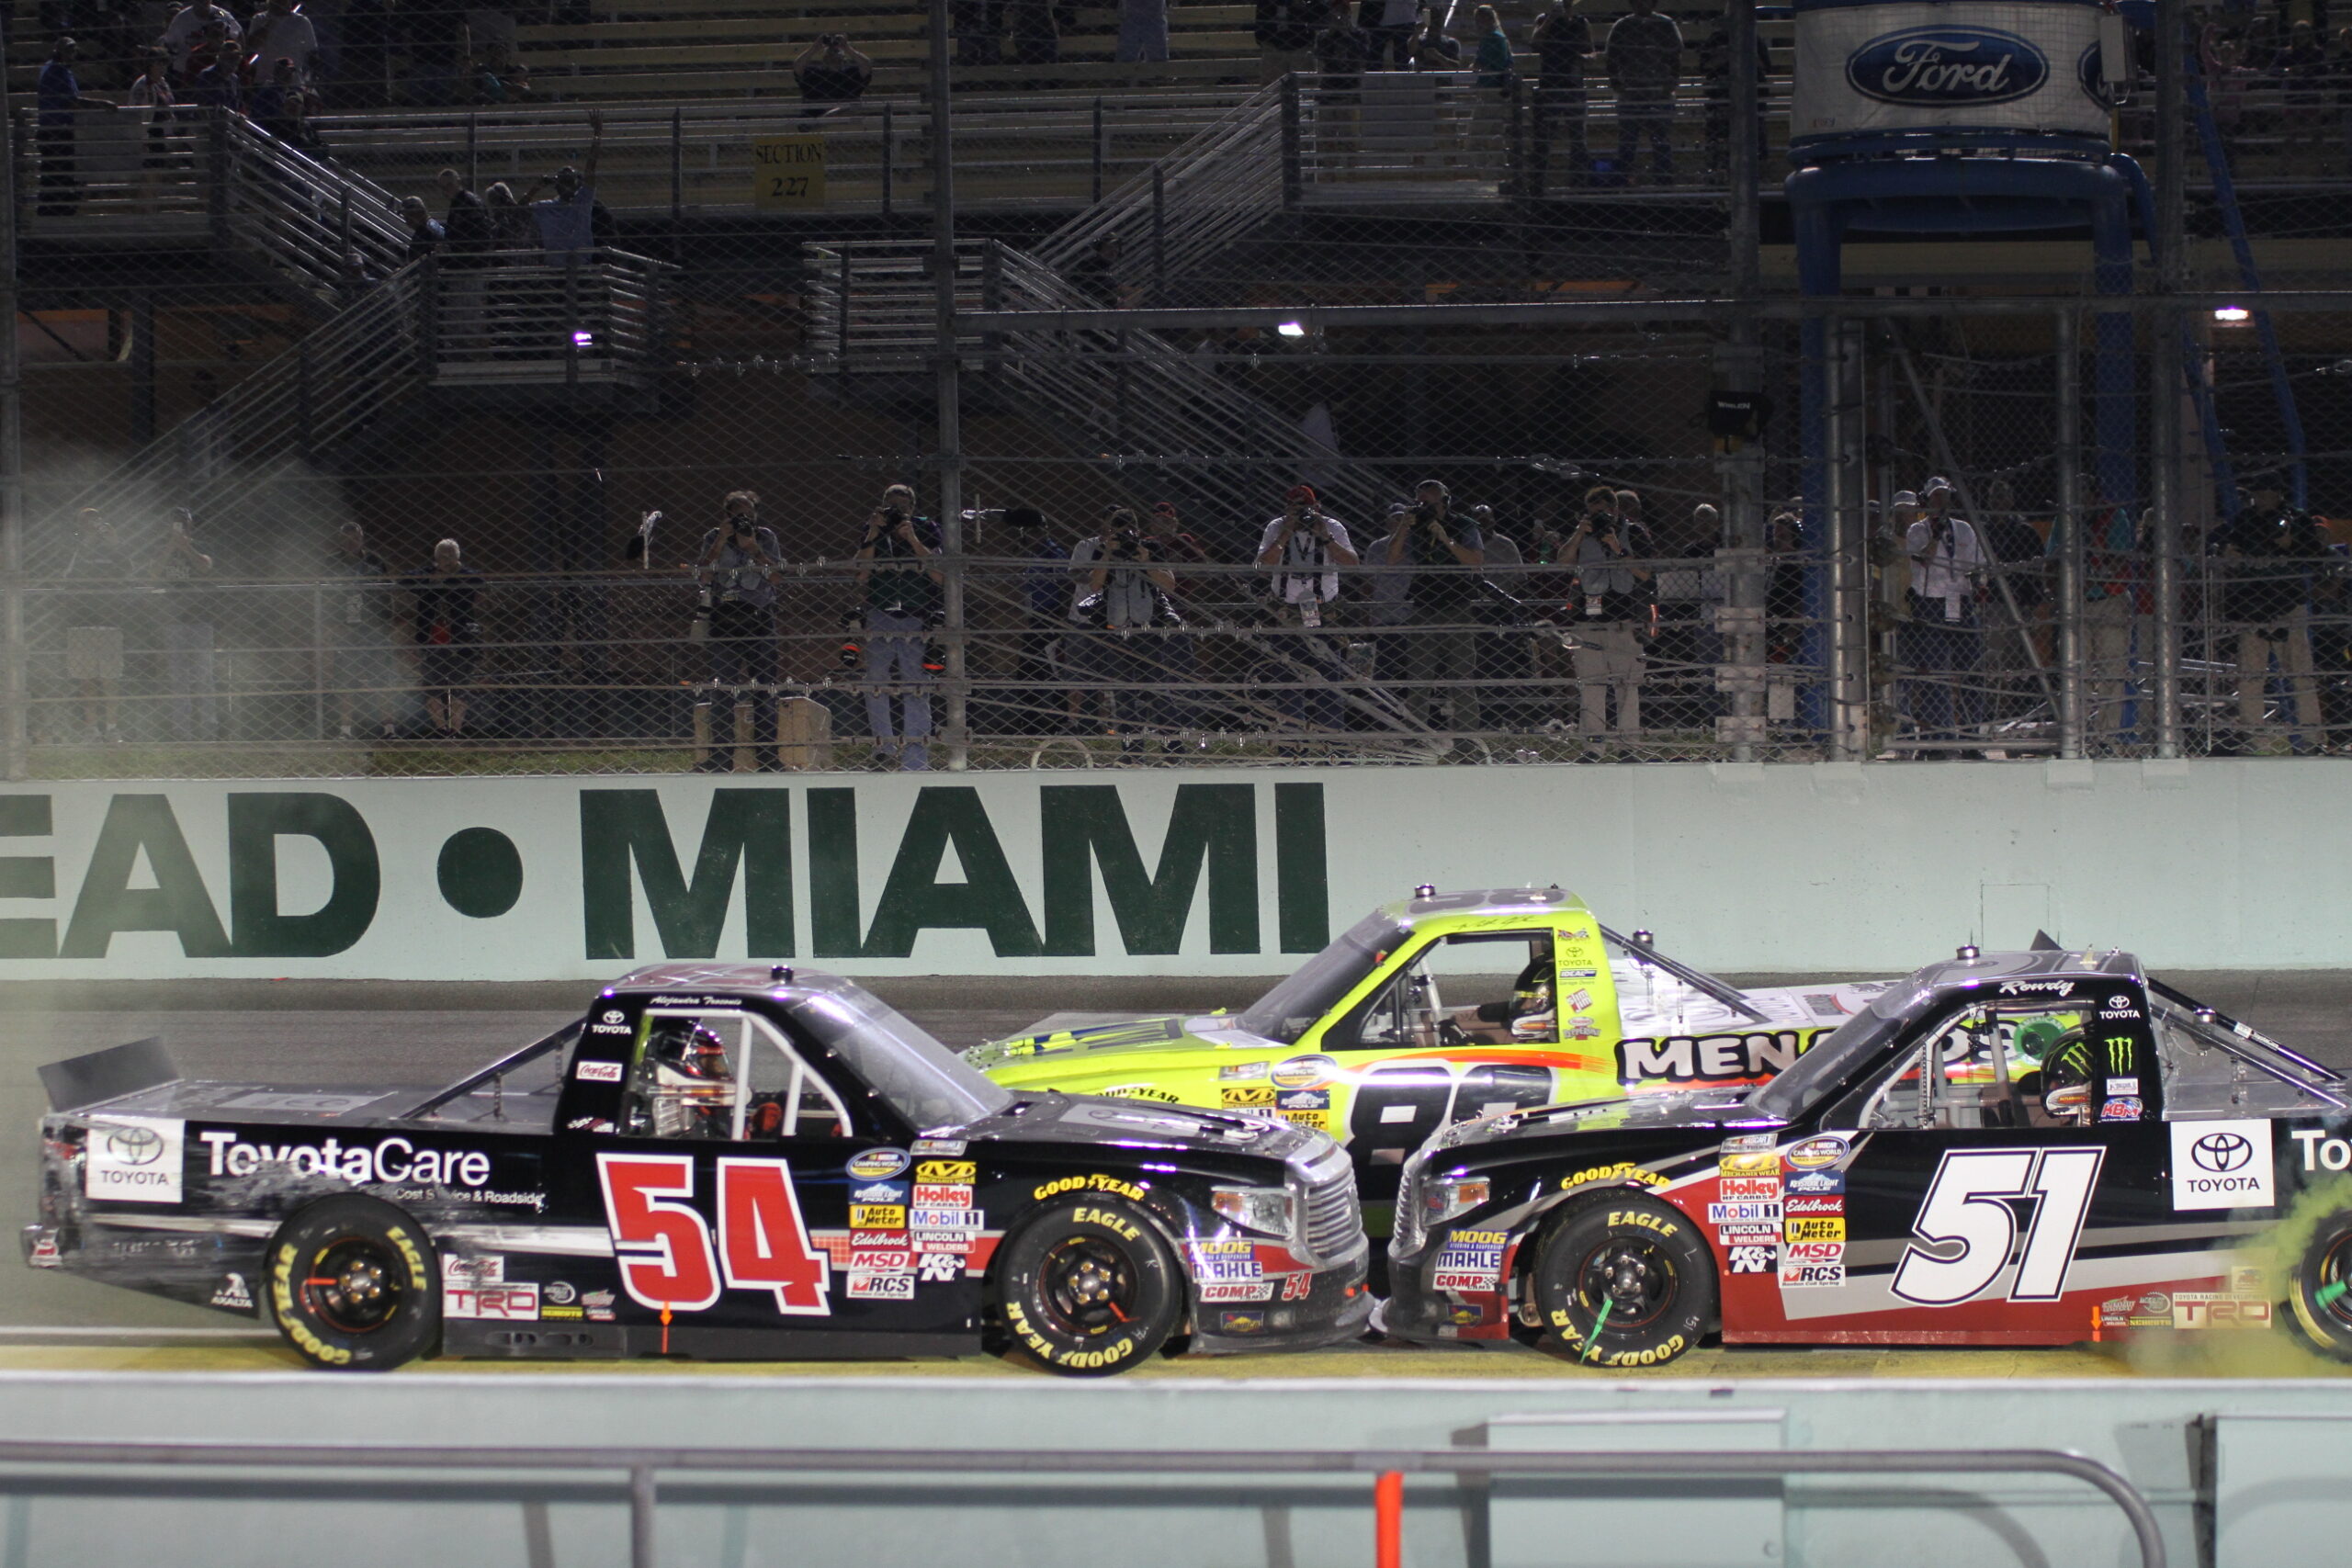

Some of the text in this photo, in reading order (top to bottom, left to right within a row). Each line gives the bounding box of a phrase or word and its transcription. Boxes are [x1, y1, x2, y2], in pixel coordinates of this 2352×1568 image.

[1883, 39, 2012, 93] Ford
[755, 143, 822, 164] SECTION
[772, 176, 809, 197] 227
[581, 782, 1329, 960] MIAMI
[1998, 979, 2075, 998] Rowdy
[2098, 1010, 2141, 1021] TOYOTA
[592, 1024, 632, 1035] TOYOTA
[1291, 1112, 1319, 1121] Auto
[2100, 1102, 2140, 1118] KBM
[100, 1169, 170, 1186] TOYOTA
[1560, 1162, 1673, 1190] GOODYEAR
[1759, 1168, 1781, 1177] WEAR
[1034, 1173, 1146, 1201] GOODYEAR
[1721, 1179, 1778, 1200] Holley
[2187, 1176, 2261, 1193] TOYOTA
[472, 1191, 482, 1201] &
[916, 1187, 971, 1206] Holley
[1712, 1204, 1758, 1219] Mobil
[1785, 1198, 1843, 1213] Edelbrock
[865, 1216, 901, 1226] Meter
[914, 1211, 958, 1225] Mobil
[1073, 1206, 1141, 1242] EAGLE
[1607, 1211, 1679, 1238] EAGLE
[1803, 1220, 1835, 1229] Auto
[1722, 1224, 1771, 1235] LINCOLN
[1887, 1145, 2108, 1308] 51
[595, 1153, 831, 1316] 54
[851, 1232, 909, 1247] Edelbrock
[916, 1232, 964, 1242] LINCOLN
[1450, 1230, 1509, 1245] MOOG
[1733, 1235, 1777, 1243] WELDERS
[1800, 1229, 1842, 1240] Meter
[926, 1243, 969, 1251] WELDERS
[1788, 1243, 1842, 1258] MSD
[386, 1225, 428, 1292] EAGLE
[854, 1253, 905, 1268] MSD
[1437, 1252, 1501, 1268] MAHLE
[1435, 1275, 1484, 1287] COMP
[1800, 1266, 1842, 1282] RCS
[869, 1277, 910, 1292] RCS
[1282, 1271, 1313, 1302] 54
[1204, 1286, 1258, 1299] COMP
[210, 1296, 254, 1309] AXALTA
[445, 1289, 537, 1318] TRD
[2174, 1300, 2270, 1328] TRD
[1006, 1301, 1134, 1369] GOODYEAR
